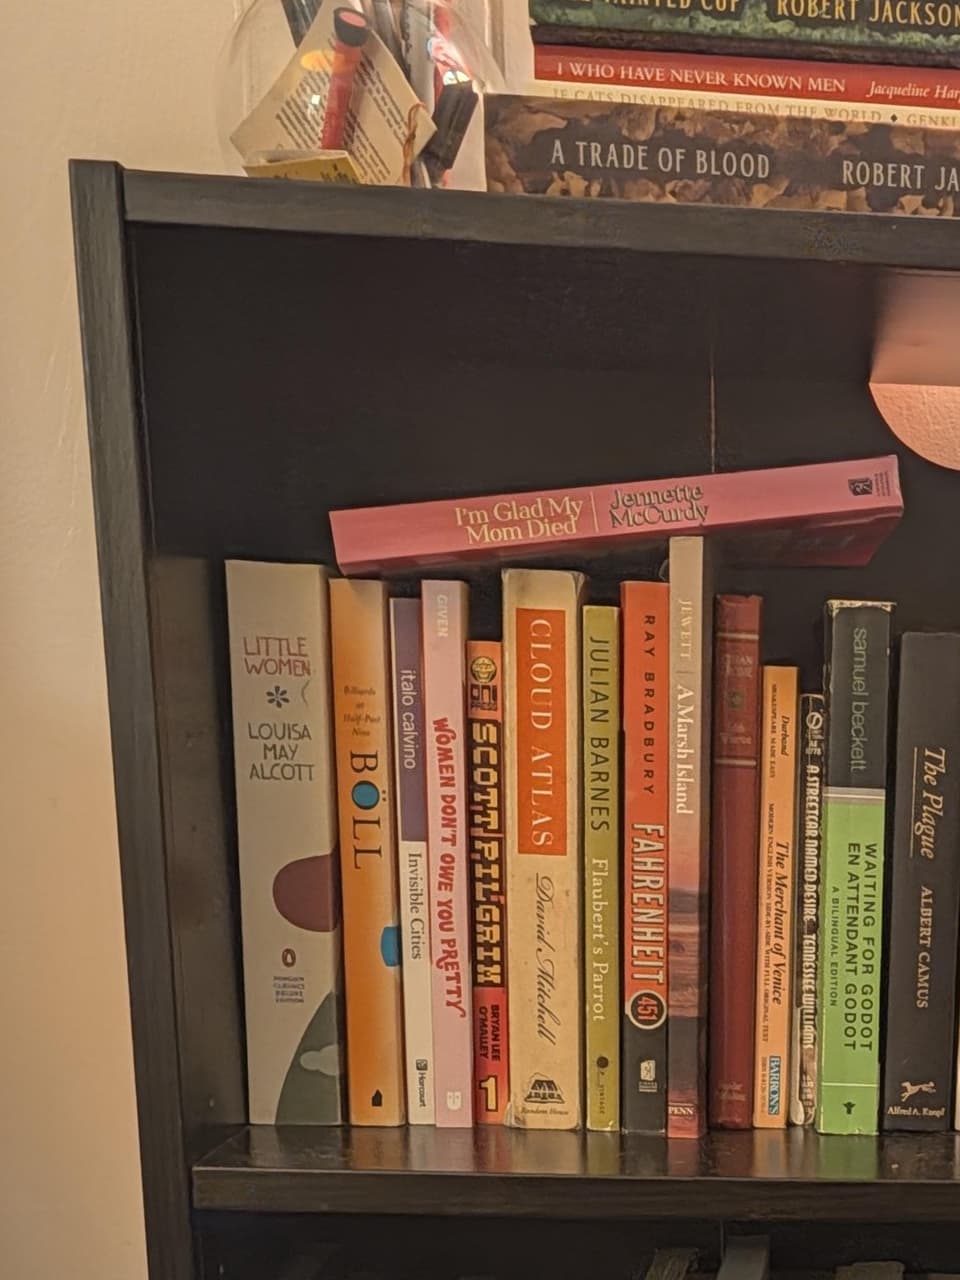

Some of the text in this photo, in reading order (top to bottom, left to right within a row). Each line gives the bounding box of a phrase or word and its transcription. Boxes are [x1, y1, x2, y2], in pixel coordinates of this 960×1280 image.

[777, 0, 855, 21] ROBERT
[556, 63, 563, 76] I
[570, 62, 615, 79] WHO
[620, 64, 665, 82] HAVE
[669, 67, 727, 86] NEVER
[733, 70, 802, 89] KNOWN
[808, 77, 846, 93] MEN
[867, 80, 930, 101] Jacqueline
[551, 139, 564, 167] A
[575, 140, 648, 171] TRADE
[658, 144, 686, 173] OF
[695, 147, 771, 179] BLOOD
[842, 160, 926, 190] ROBERT
[455, 494, 584, 527] I'm Glad My
[466, 516, 577, 546] Mom Died
[609, 484, 704, 512] Jennette
[609, 500, 710, 530] McCurdy
[243, 635, 308, 659] LITTLE
[244, 658, 311, 678] WOMEN
[248, 721, 313, 744] LOUISA
[401, 670, 419, 768] italo calvino
[530, 619, 553, 847] CLOUD ATLAS
[851, 628, 871, 773] samuel beckett
[250, 763, 315, 782] ALCOTT
[262, 743, 299, 762] MAY
[676, 684, 694, 814] A Marsh Island
[588, 636, 611, 1022] JULIAN BARNES Flaubert's Parrot
[632, 614, 665, 1023] RAY BRADBURY FAHRENHEIT 451
[433, 717, 467, 1018] WOMEN DON'T OWE YOU PRETTY
[913, 747, 947, 1008] The Plague ALBERT CAMUS
[408, 853, 426, 960] Invisible Cities
[771, 841, 789, 1006] The Merchant of Venice
[534, 873, 560, 1042] David Mitchell
[860, 843, 879, 1052] WAITING FOR GODOT
